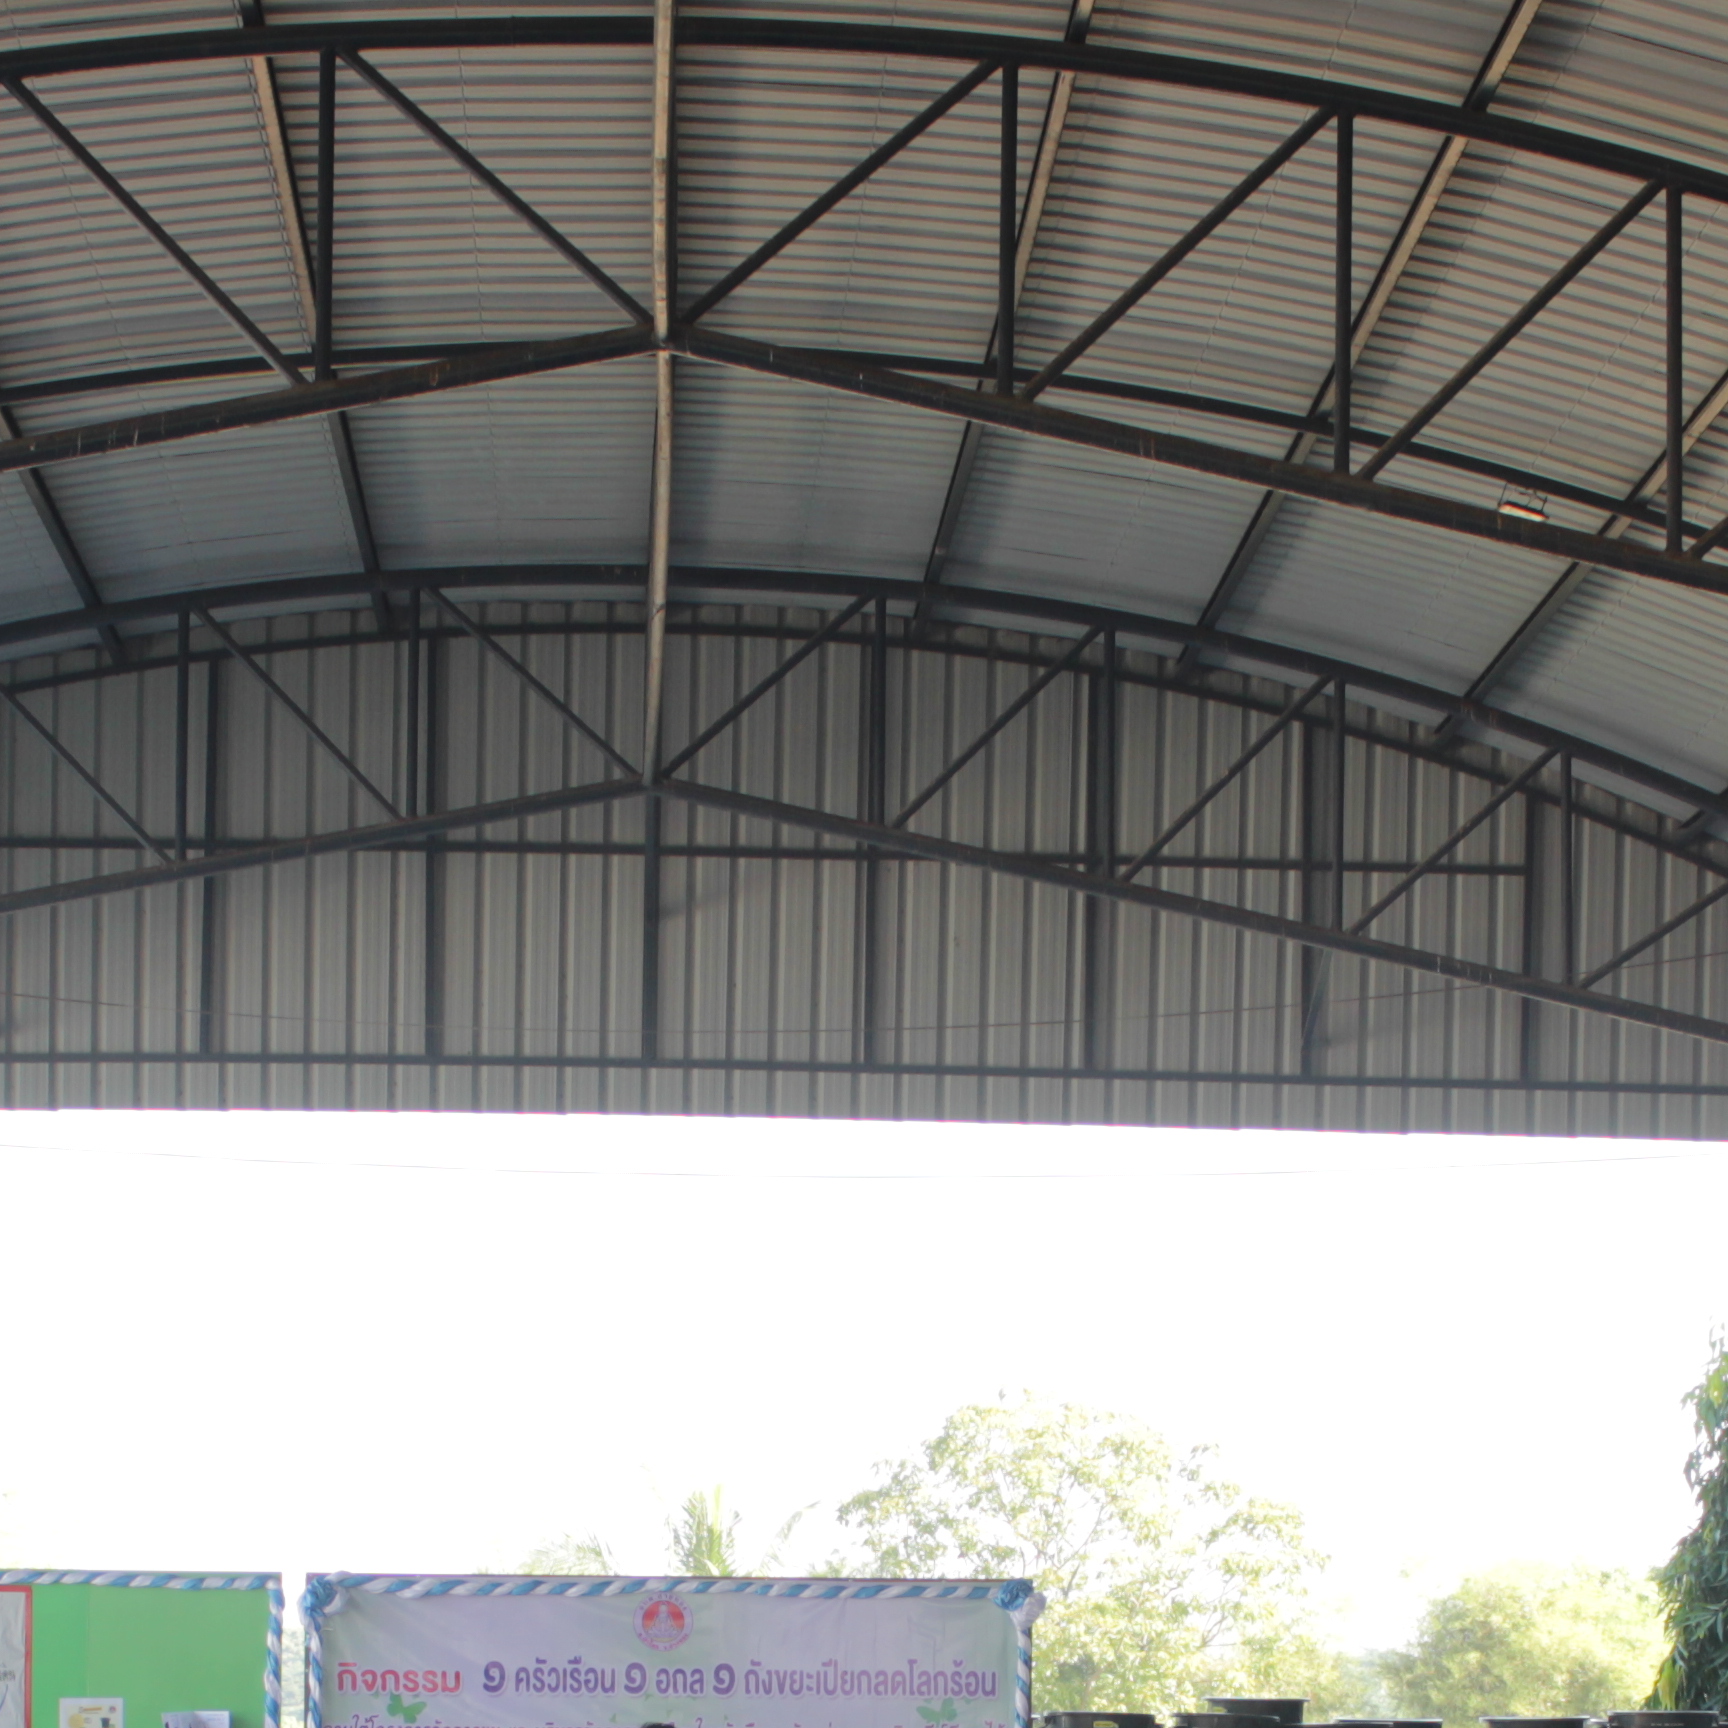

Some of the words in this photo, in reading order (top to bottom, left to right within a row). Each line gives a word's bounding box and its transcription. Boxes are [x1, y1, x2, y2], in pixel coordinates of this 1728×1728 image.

[337, 1662, 462, 1694] กิจกรรม
[483, 1661, 506, 1694] ๑
[515, 1656, 616, 1694] ครัวเรือน
[625, 1663, 647, 1694] ๑
[712, 1664, 735, 1695] ๑
